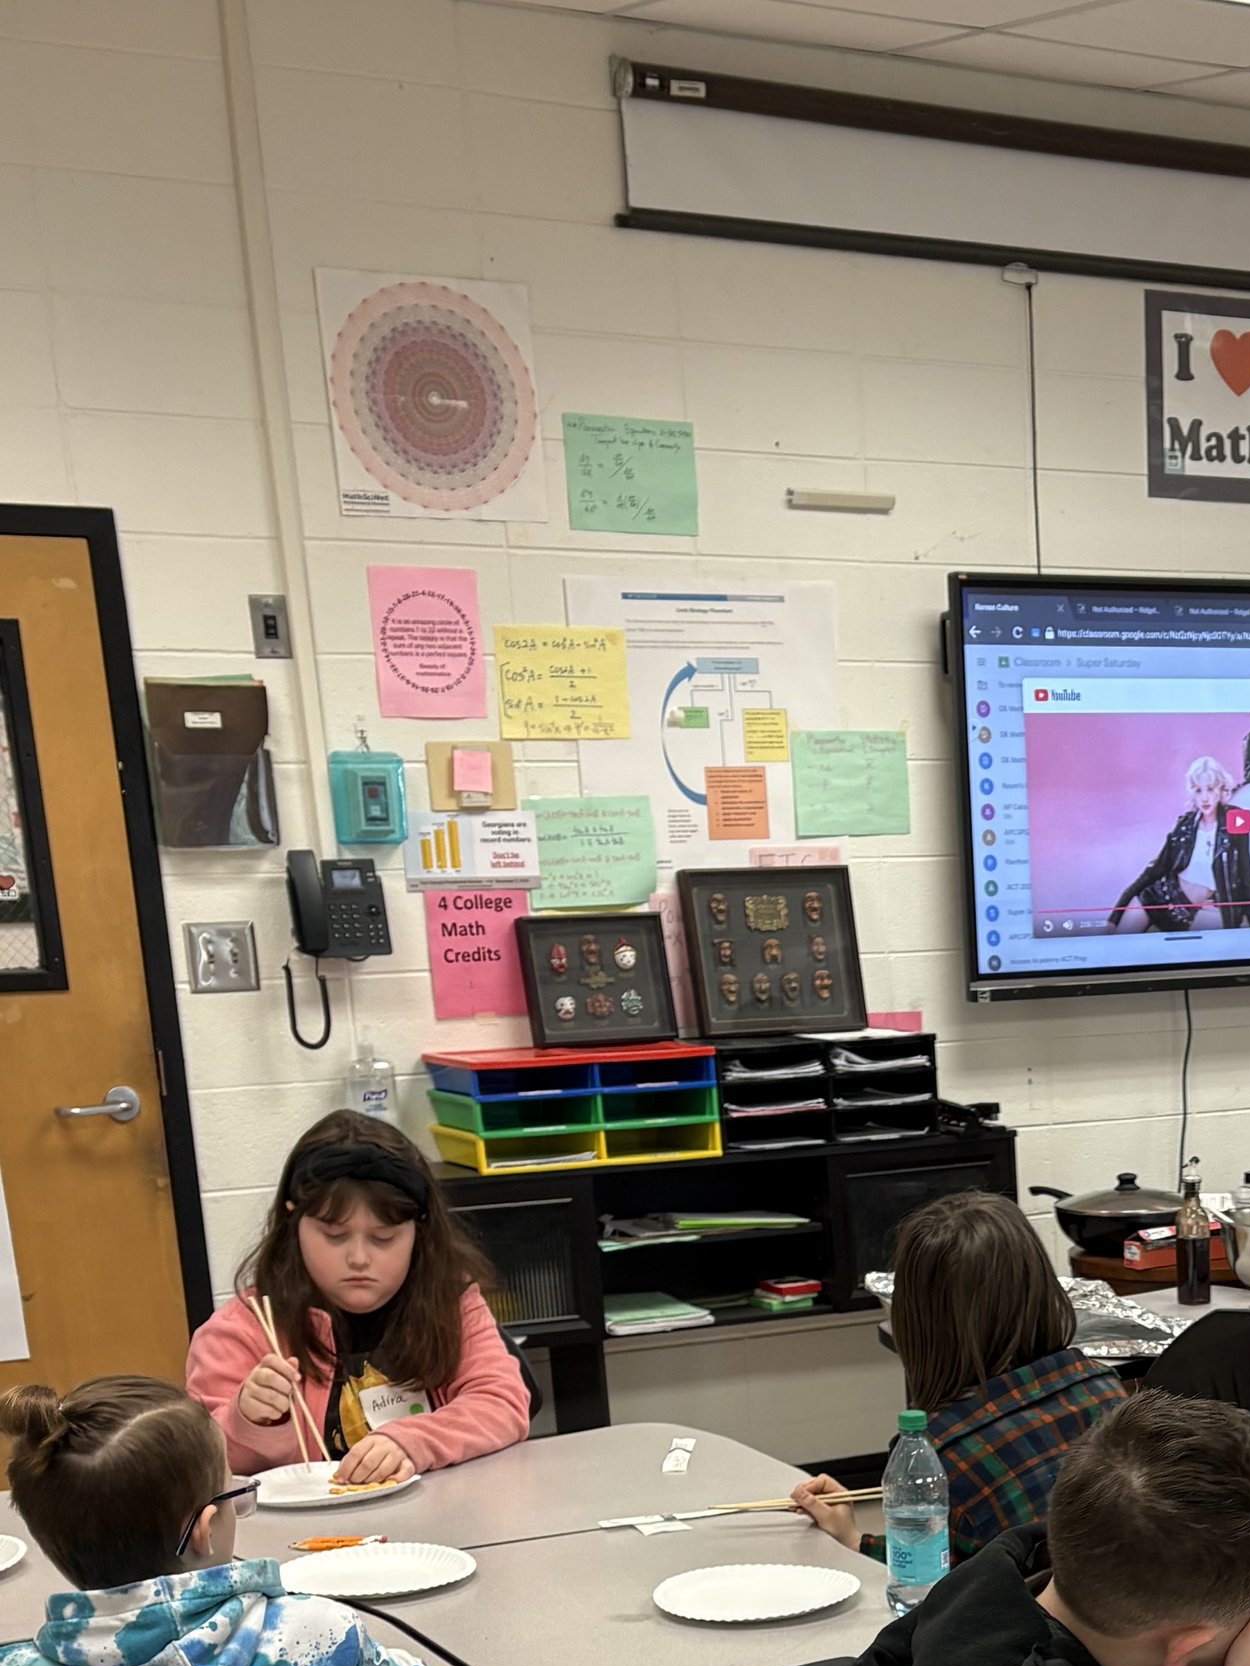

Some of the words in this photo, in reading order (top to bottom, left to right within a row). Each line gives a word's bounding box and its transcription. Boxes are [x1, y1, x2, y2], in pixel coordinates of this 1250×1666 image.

[1174, 333, 1195, 381] I
[1014, 657, 1061, 667] Classroom
[1076, 658, 1102, 669] Super
[1103, 658, 1141, 669] Saturday
[1051, 689, 1081, 702] YouTube
[482, 821, 512, 830] Georgians
[491, 829, 510, 837] voting
[438, 896, 448, 910] 4
[453, 896, 512, 911] College
[441, 923, 486, 937] Math
[444, 948, 501, 963] Credits
[372, 1394, 408, 1412] Adira
